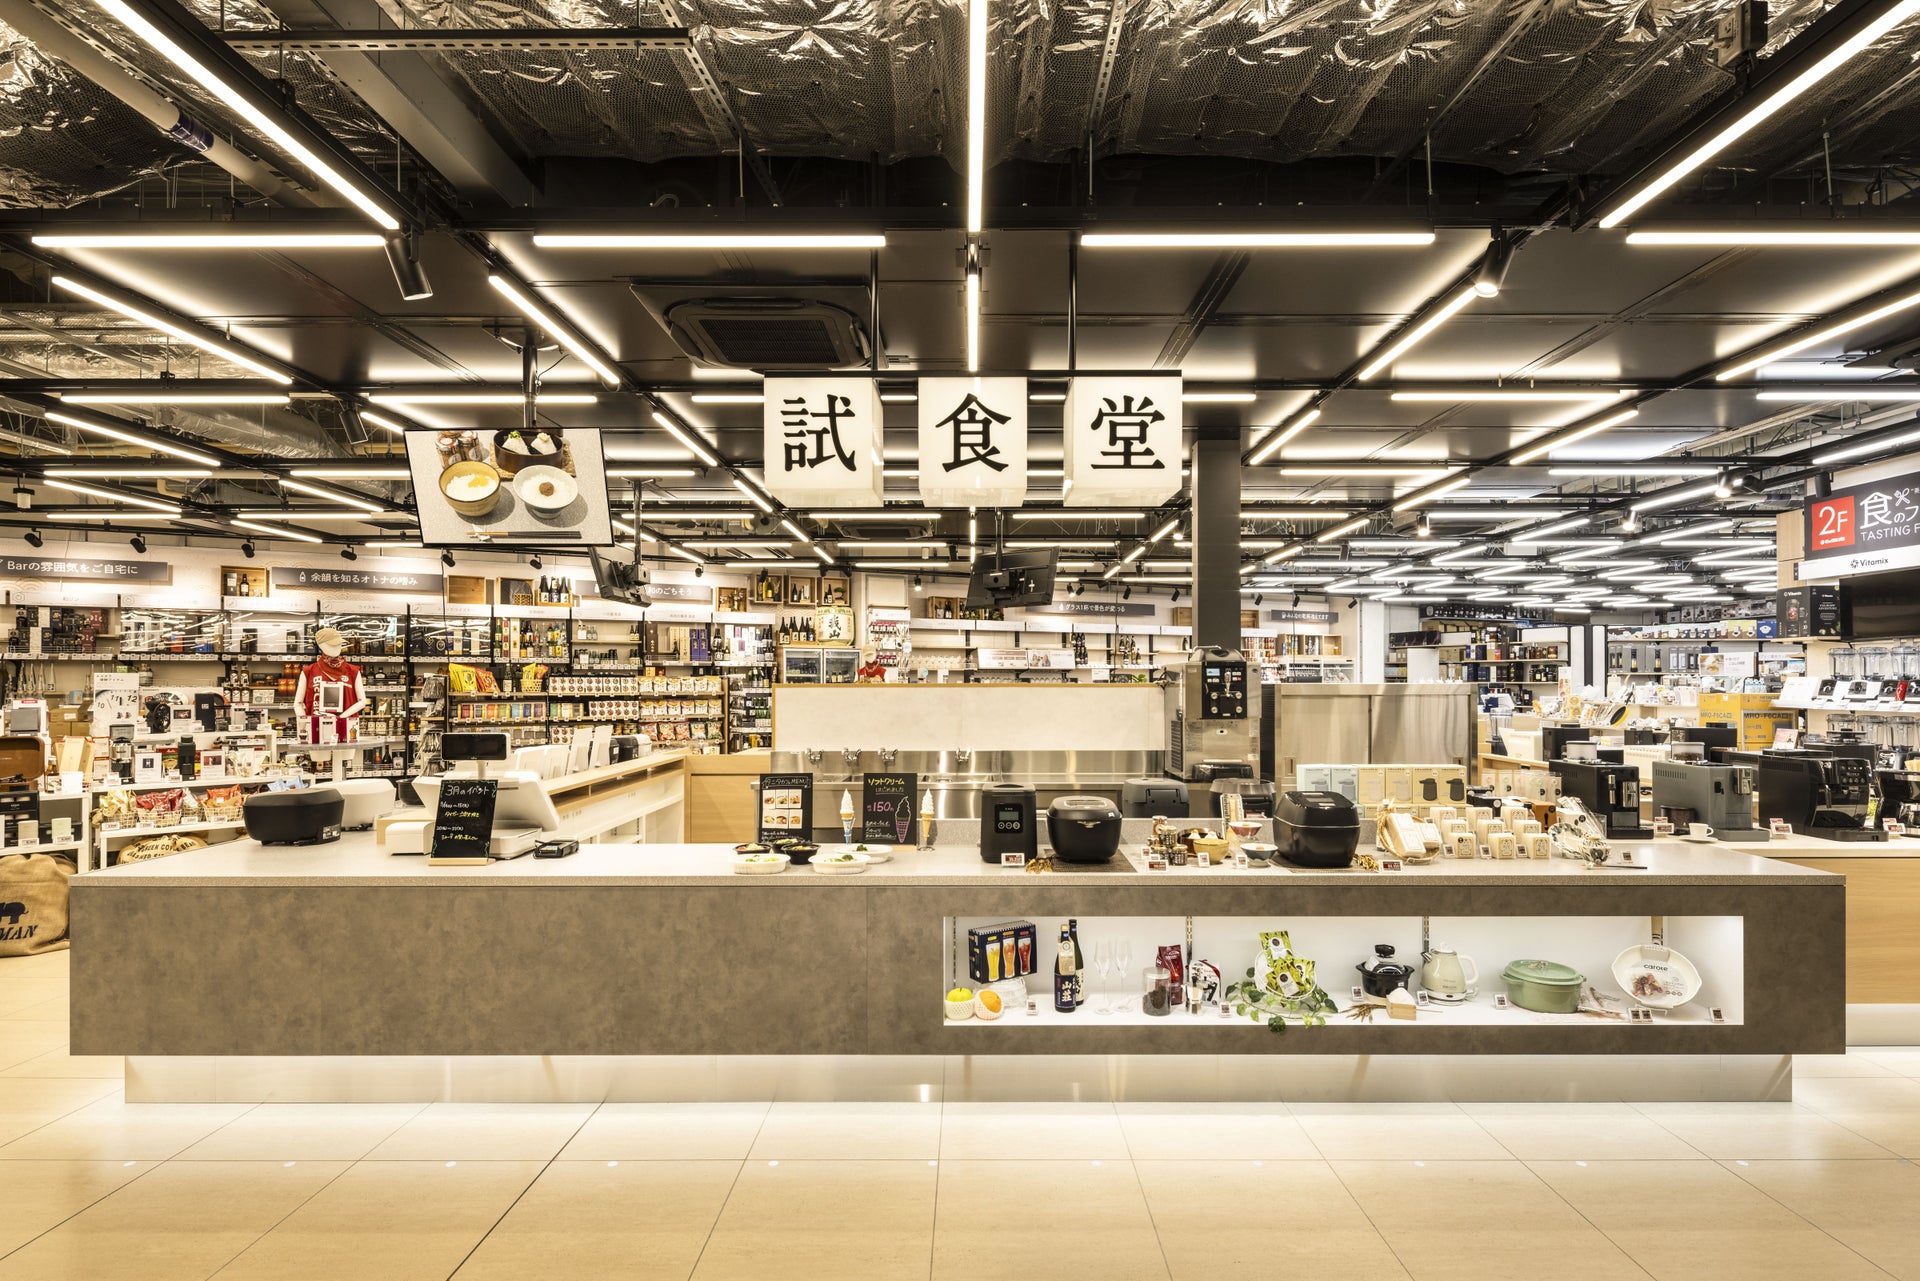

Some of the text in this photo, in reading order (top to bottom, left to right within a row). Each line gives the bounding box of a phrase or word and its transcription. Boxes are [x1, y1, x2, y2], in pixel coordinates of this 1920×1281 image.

[780, 393, 1165, 472] 試食堂
[1818, 505, 1849, 536] 2F
[1860, 524, 1911, 542] TASTING
[7, 560, 138, 575] Barの雰囲気をご自宅に
[1860, 557, 1889, 567] Vitamix
[127, 694, 137, 703] 12
[867, 777, 905, 786] ソフトクリーム
